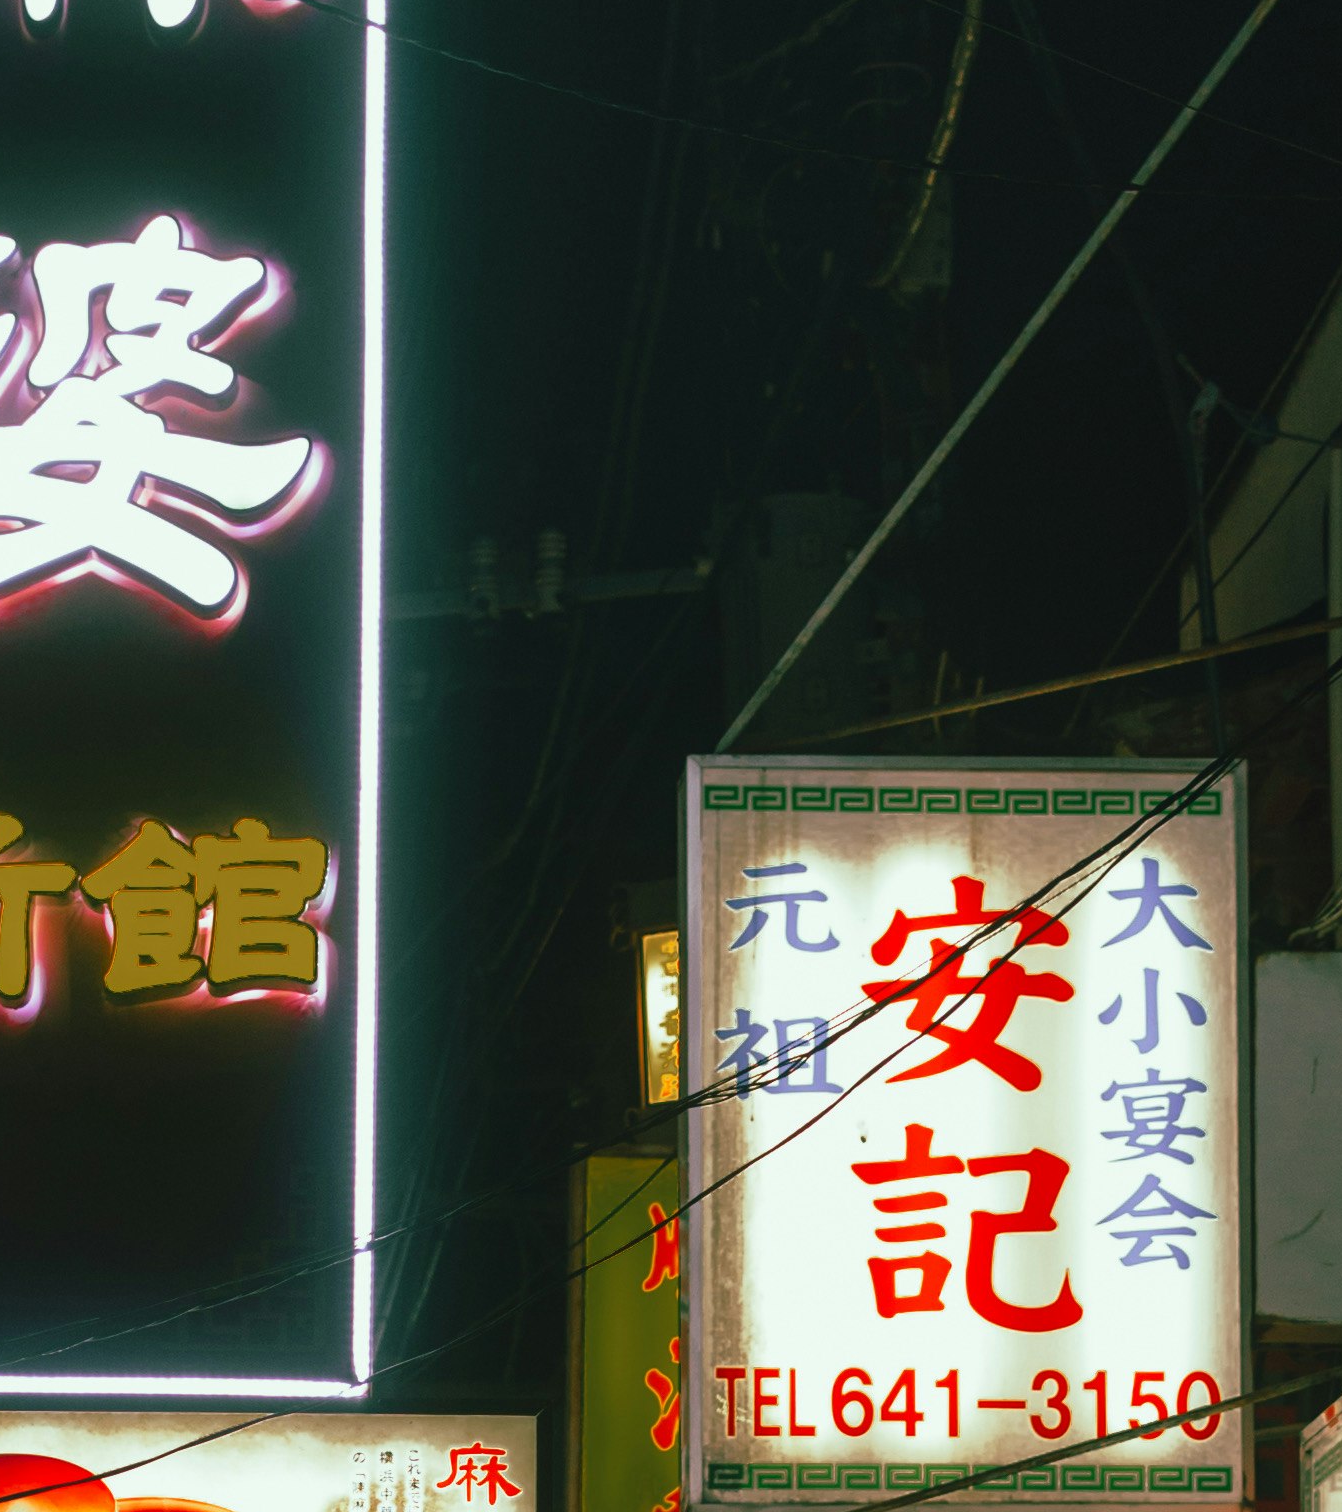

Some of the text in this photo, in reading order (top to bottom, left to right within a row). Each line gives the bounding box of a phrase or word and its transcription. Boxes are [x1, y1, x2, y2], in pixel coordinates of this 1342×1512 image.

[714, 862, 844, 1100] 元祖
[851, 875, 1083, 1333] 安記
[1095, 857, 1218, 1270] 大小宴会
